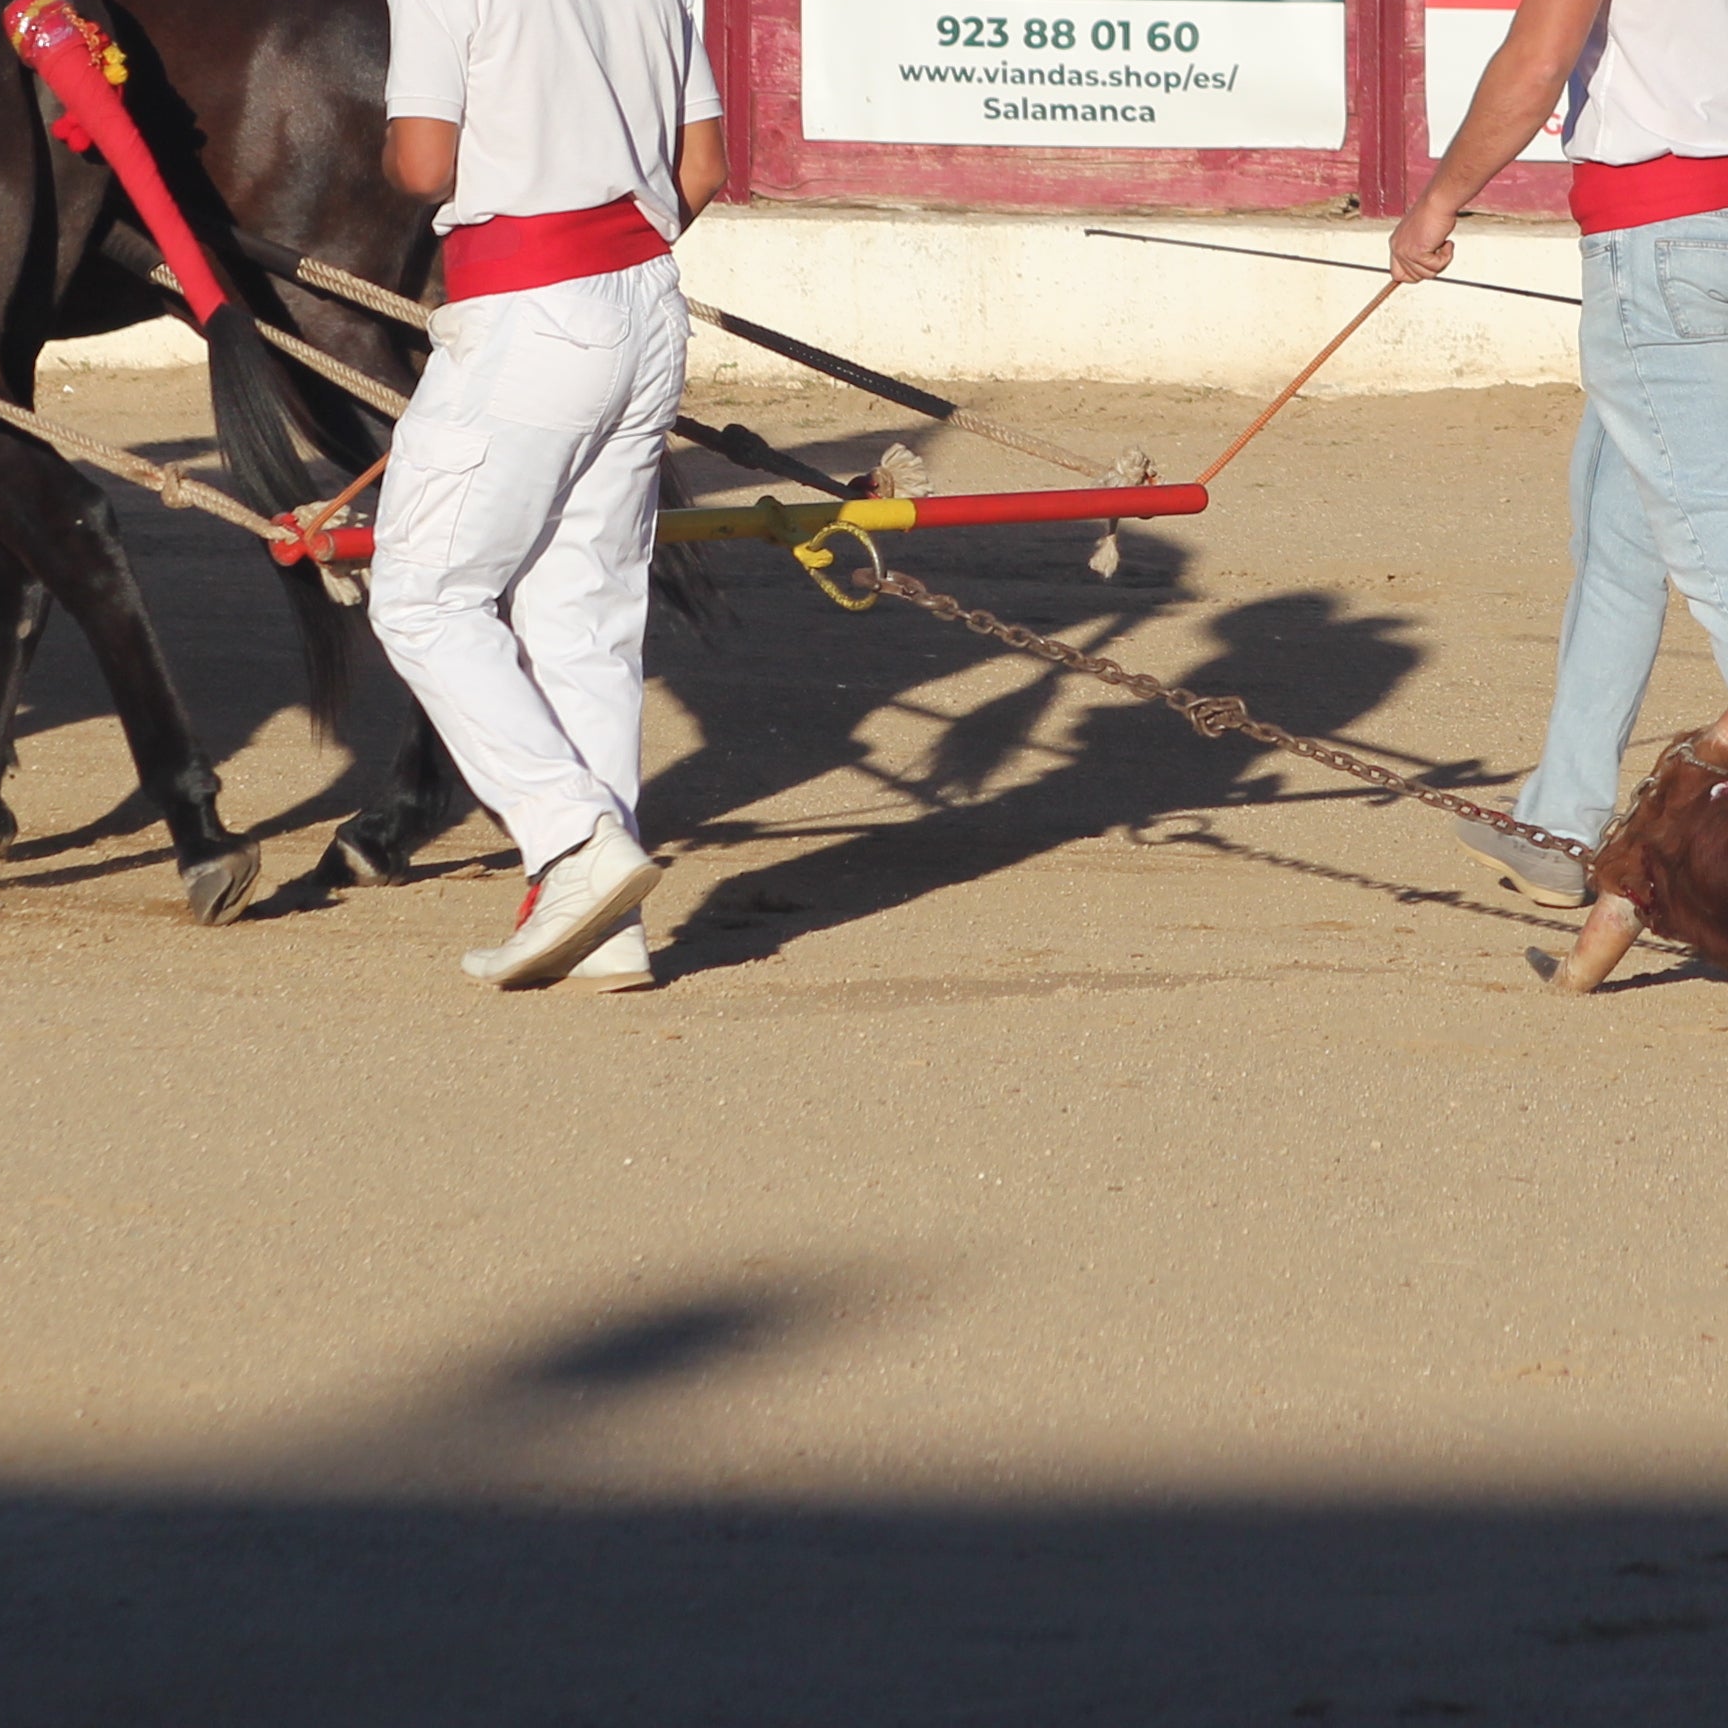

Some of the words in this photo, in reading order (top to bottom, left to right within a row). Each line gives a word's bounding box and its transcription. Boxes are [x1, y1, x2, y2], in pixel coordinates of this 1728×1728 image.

[936, 15, 1010, 49] 923
[1023, 18, 1077, 50] 88
[1091, 19, 1132, 52] 01
[1146, 20, 1200, 53] 60
[898, 61, 1240, 94] www.viandas.shop/es/
[983, 97, 1157, 123] Salamanca
